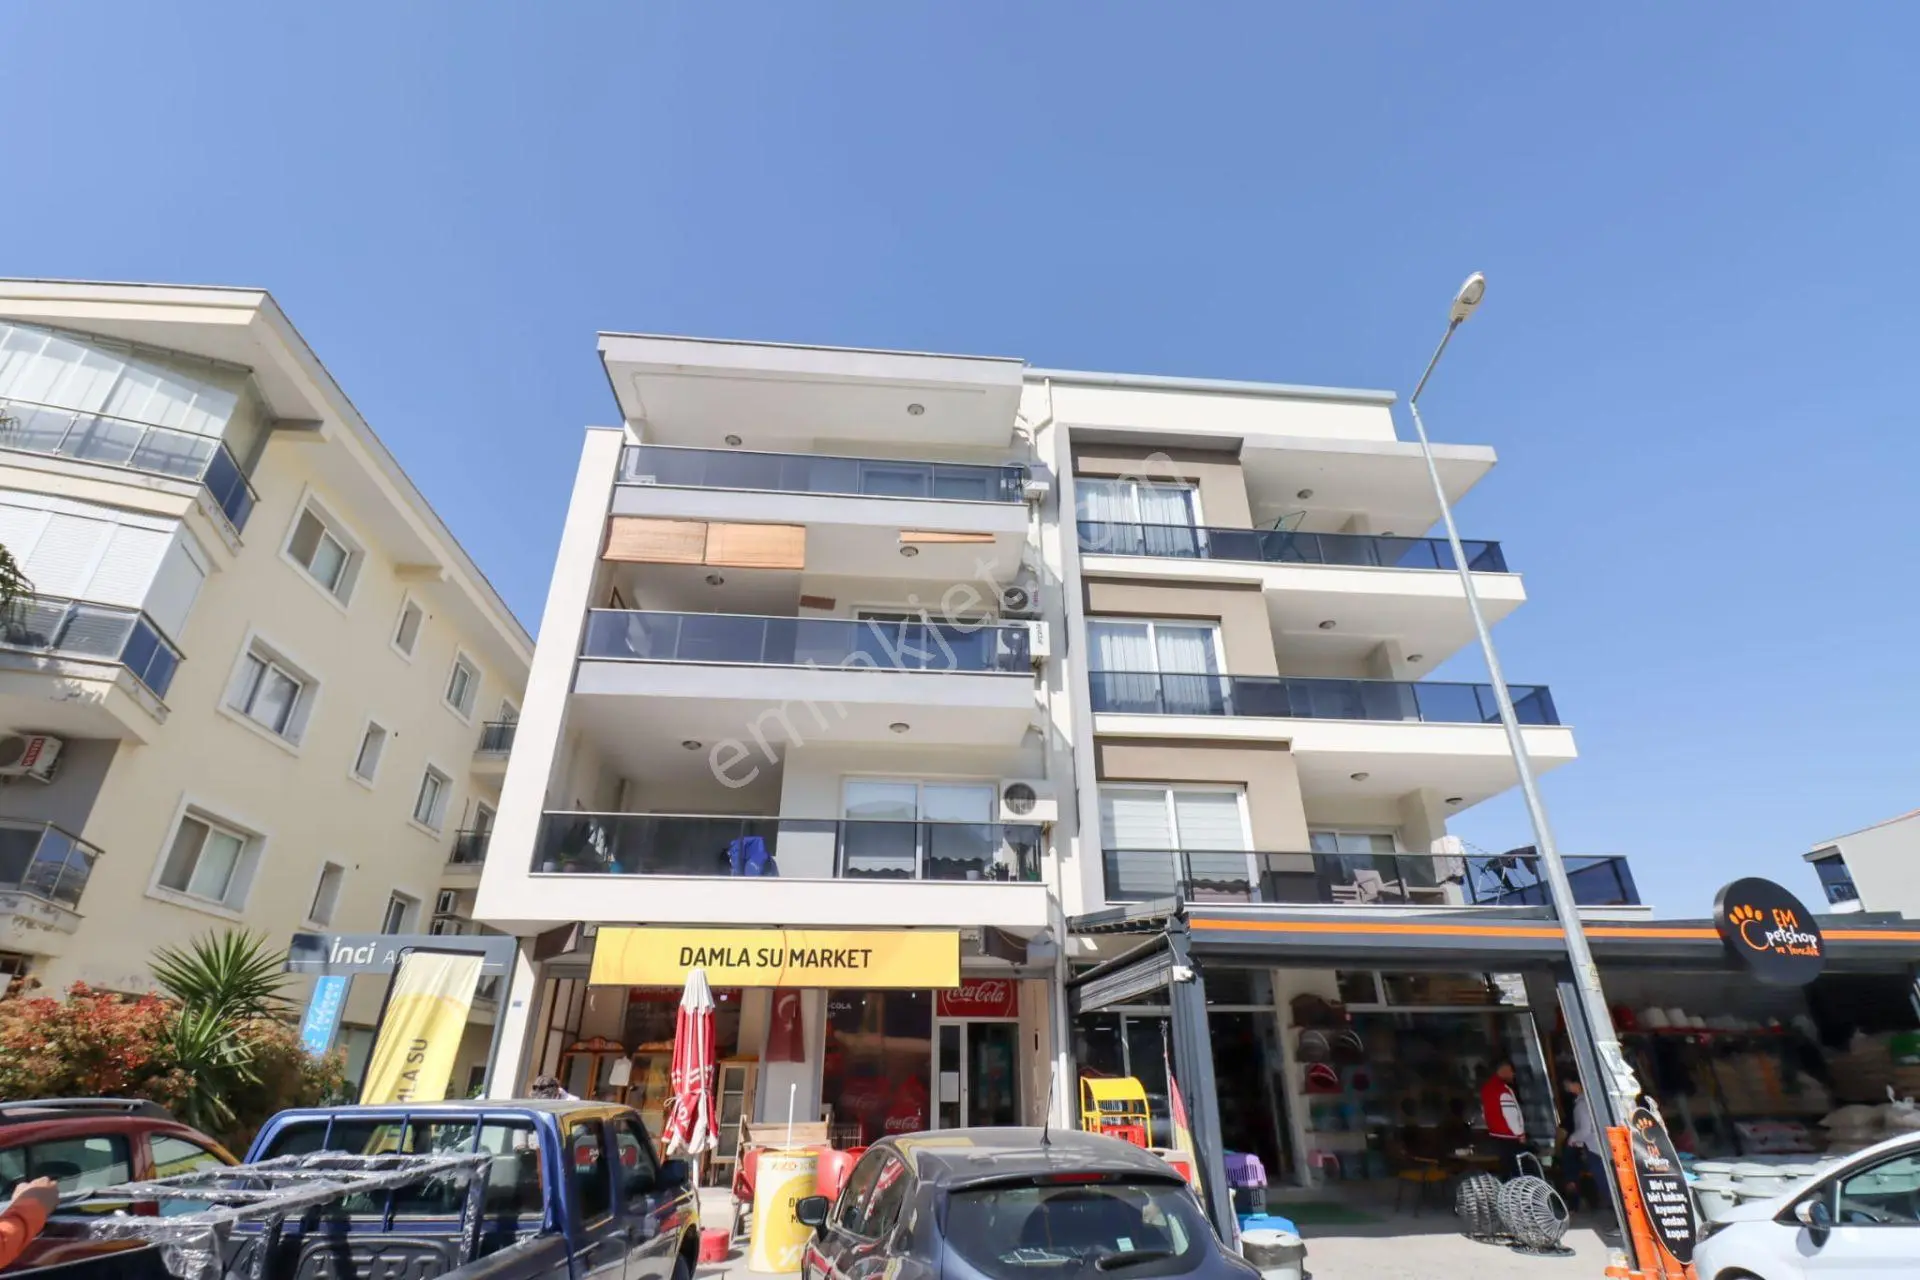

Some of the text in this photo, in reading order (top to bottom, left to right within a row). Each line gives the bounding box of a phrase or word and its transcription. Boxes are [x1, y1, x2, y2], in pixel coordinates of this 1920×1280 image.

[1772, 908, 1798, 929] EM
[1765, 924, 1818, 949] petshop
[679, 946, 873, 969] DAMLA SU MARKET
